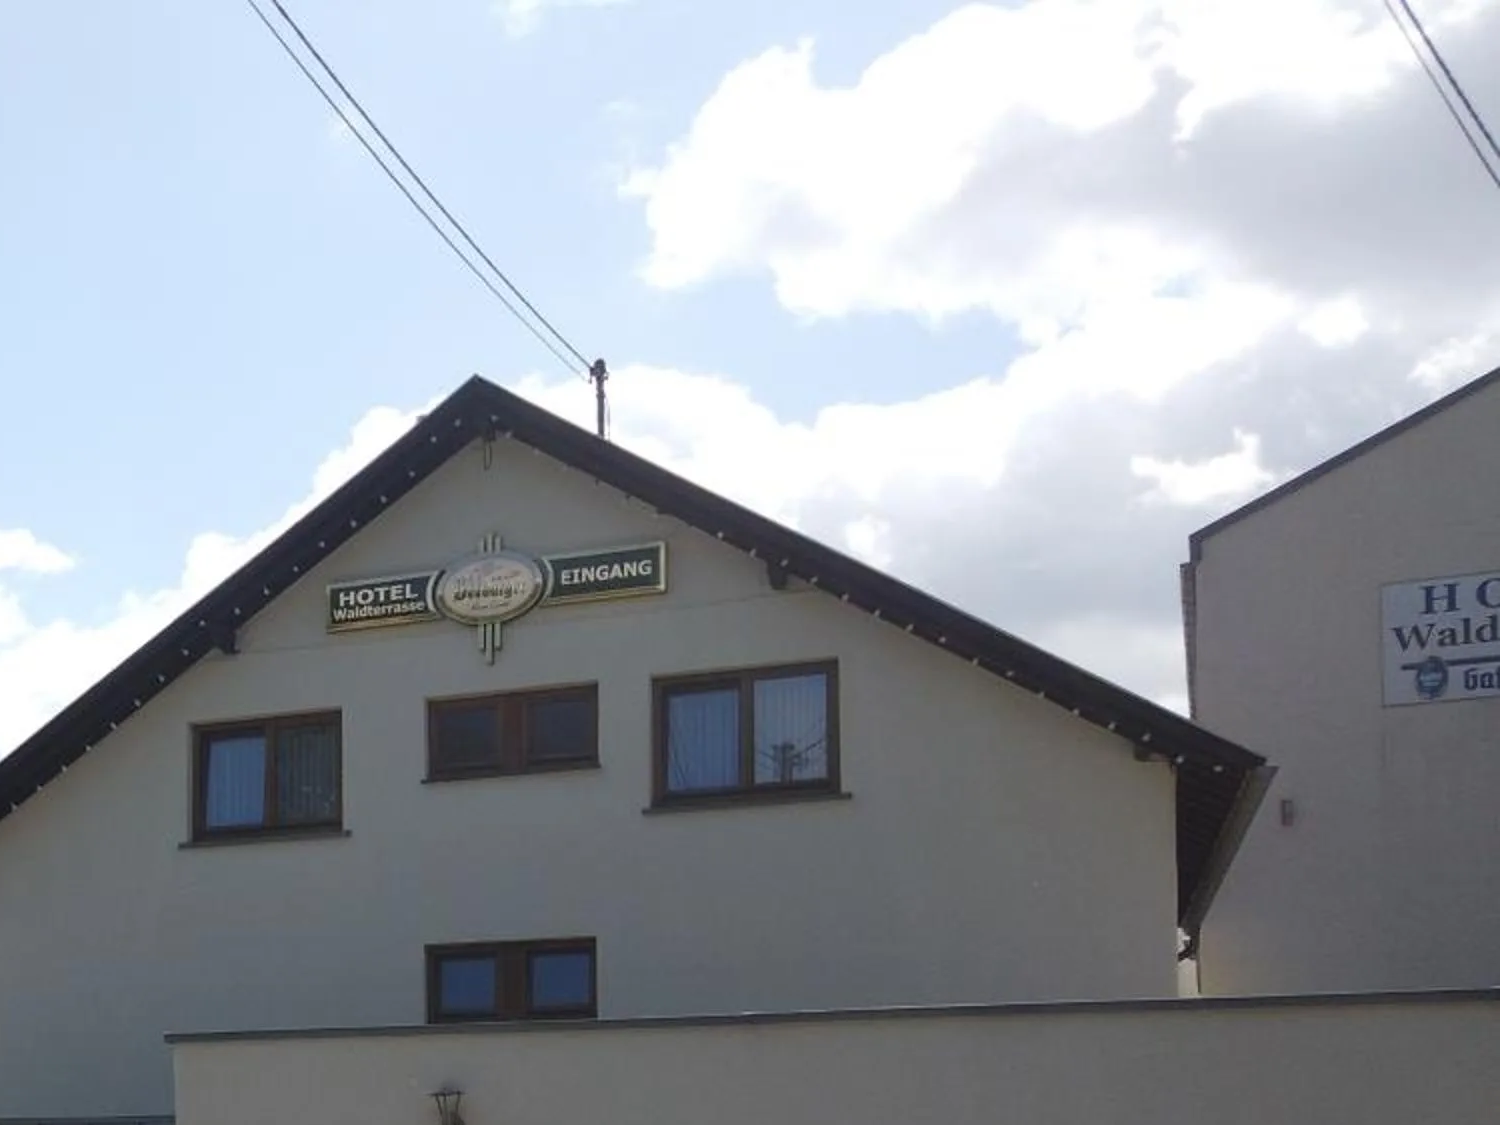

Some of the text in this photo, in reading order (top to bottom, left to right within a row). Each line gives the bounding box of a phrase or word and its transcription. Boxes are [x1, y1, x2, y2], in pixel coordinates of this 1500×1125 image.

[560, 560, 653, 586] EINGANG
[338, 583, 419, 607] HOTEL
[333, 602, 426, 622] Waldterrasse
[1391, 614, 1500, 651] Wald
